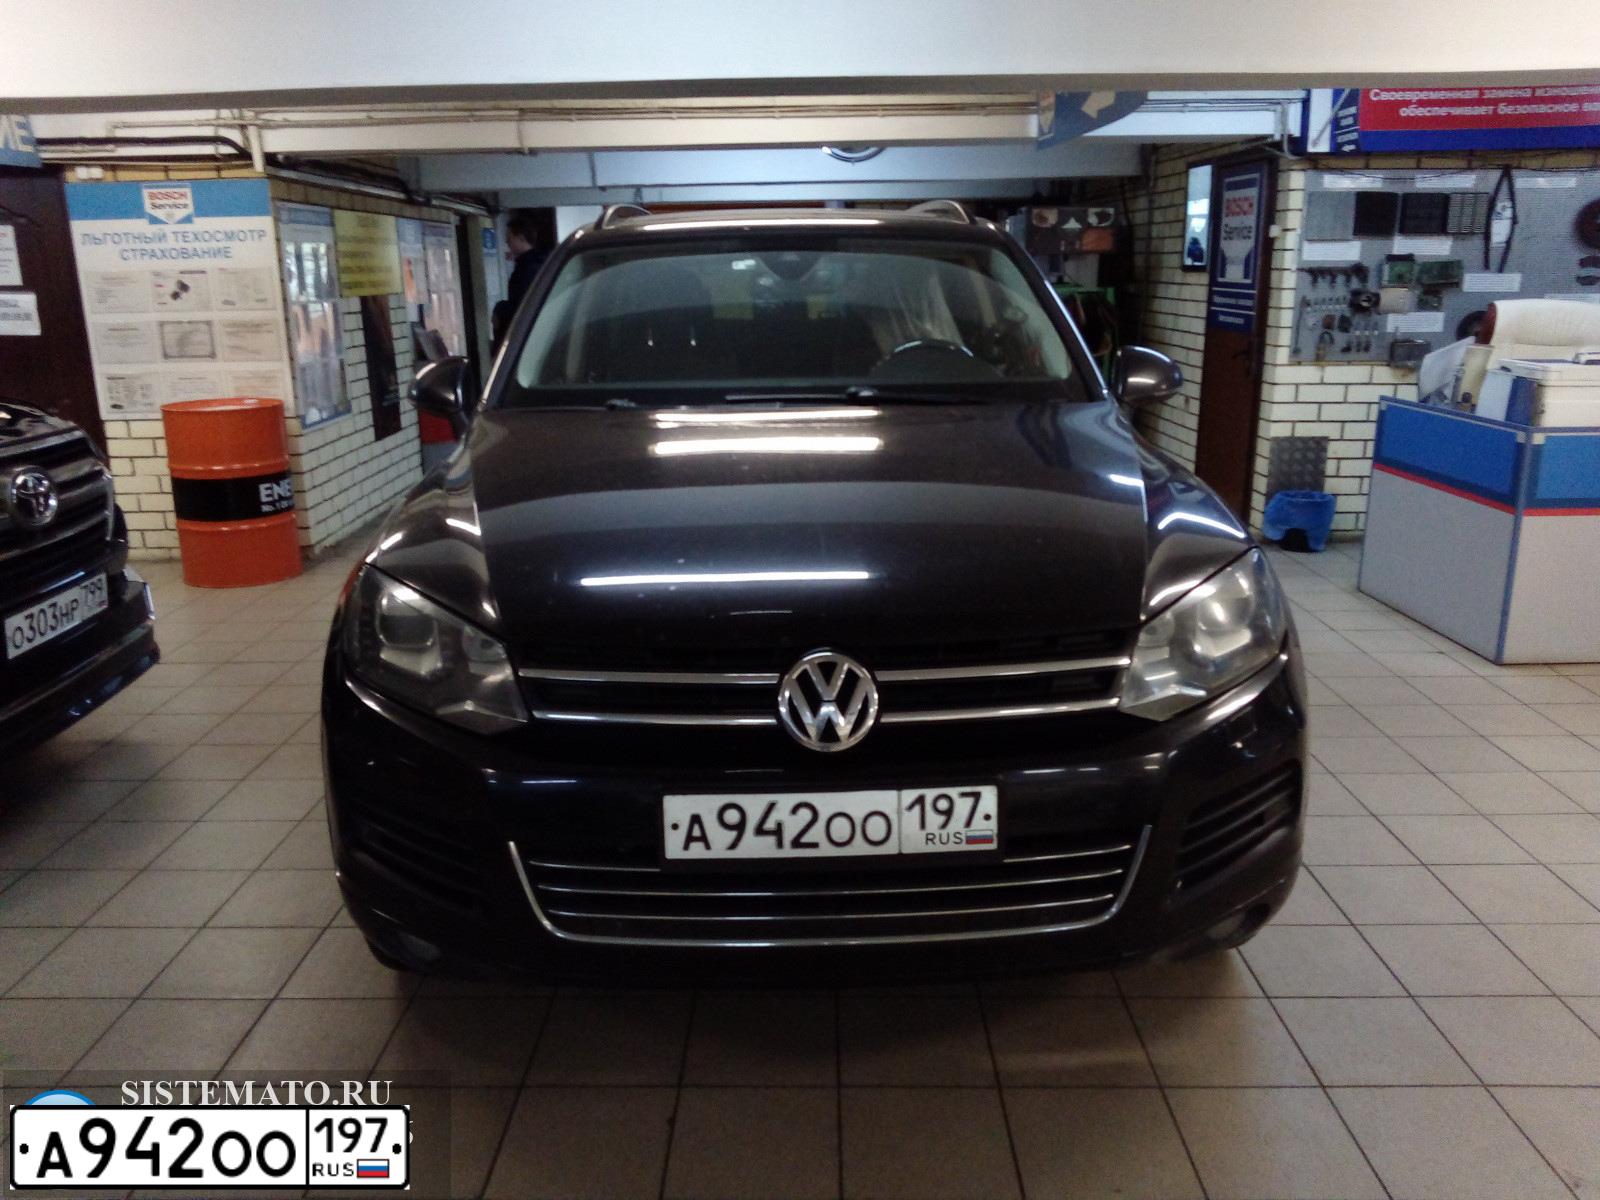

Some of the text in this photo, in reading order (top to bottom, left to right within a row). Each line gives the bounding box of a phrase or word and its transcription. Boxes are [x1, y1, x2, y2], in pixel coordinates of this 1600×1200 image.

[150, 202, 189, 210] Service
[81, 228, 267, 246] ЛЬГОТНЫЙ ТЕХОСМОТР
[120, 247, 234, 261] СТРАХОВАНИЕ
[905, 791, 982, 831] 197
[924, 831, 964, 845] RUS
